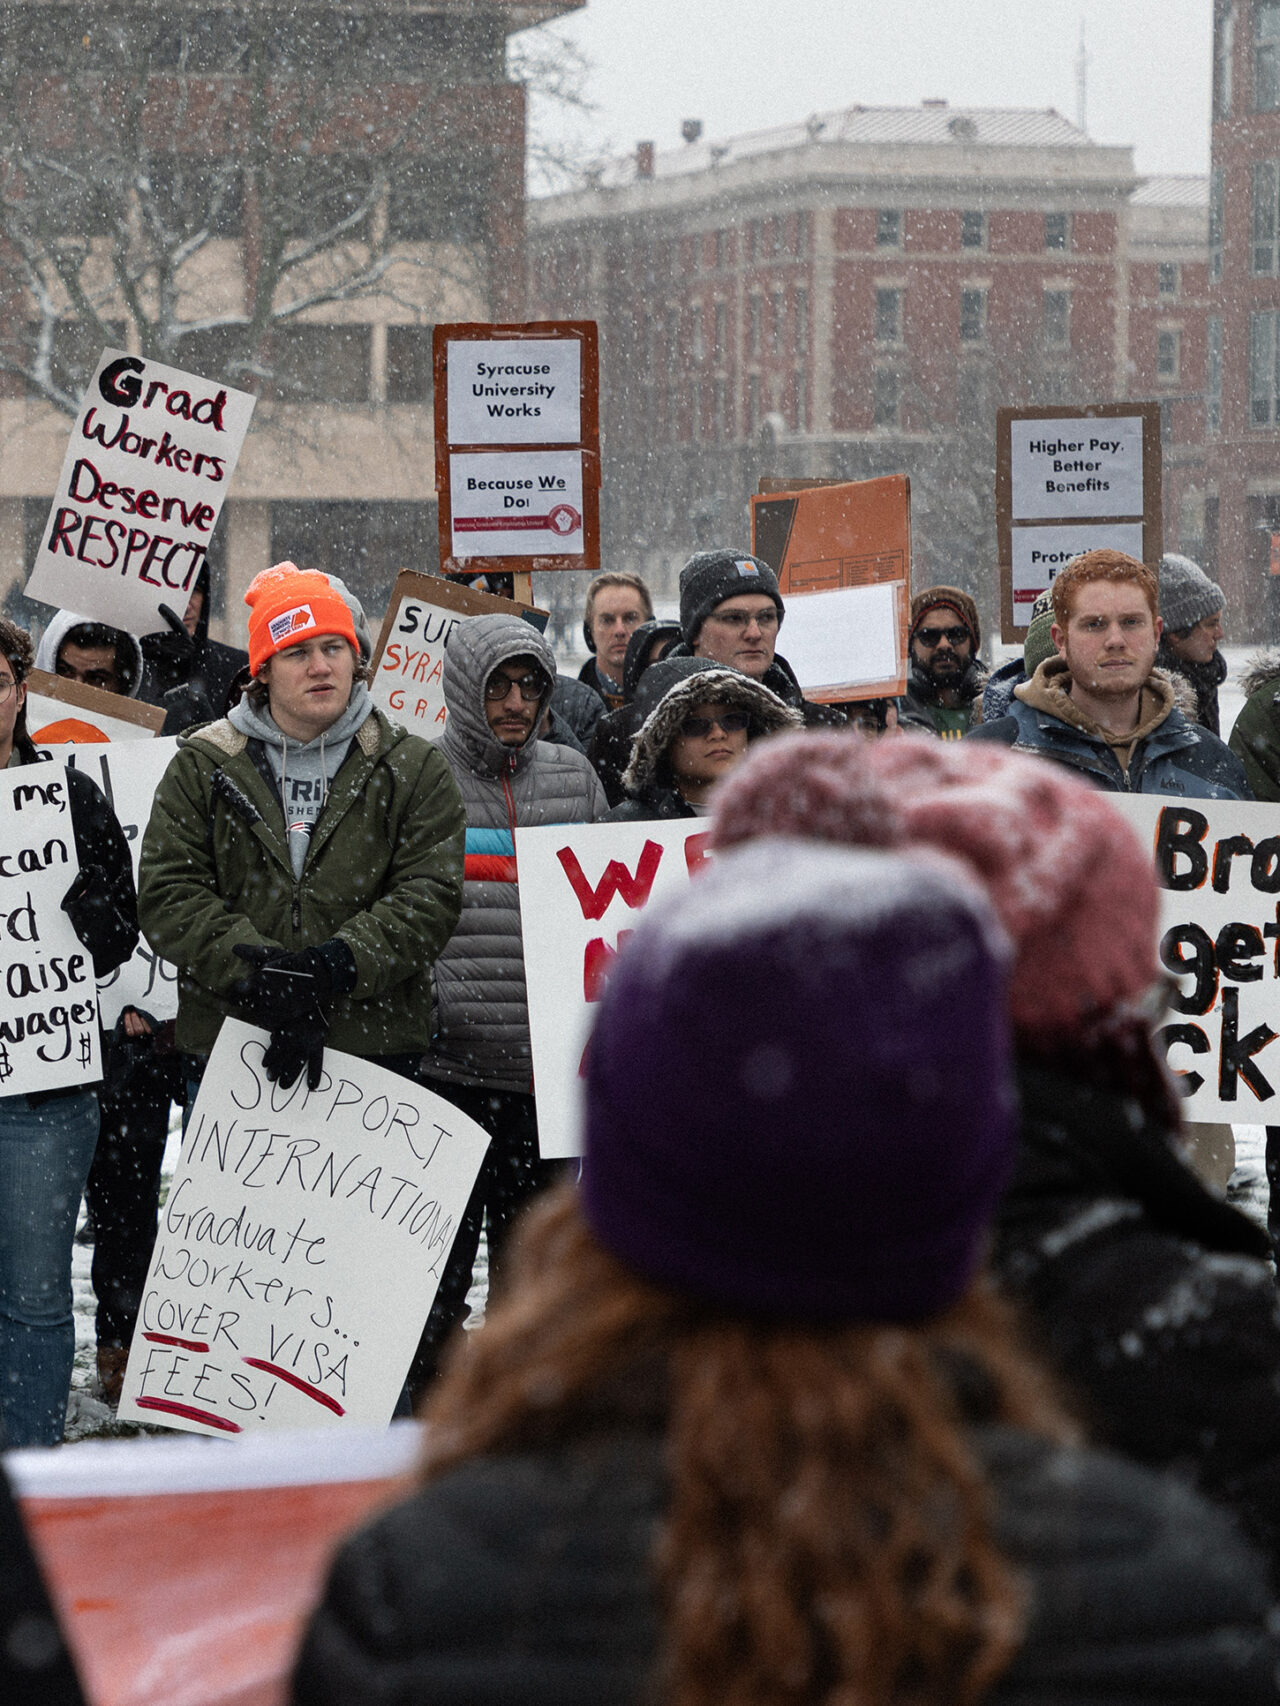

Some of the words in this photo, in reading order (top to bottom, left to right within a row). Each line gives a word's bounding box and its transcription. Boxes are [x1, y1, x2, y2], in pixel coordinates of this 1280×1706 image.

[476, 362, 551, 379] Syracuse
[98, 356, 227, 433] Grad
[472, 383, 556, 399] University
[487, 403, 542, 418] Works
[82, 407, 226, 482] Workers
[1029, 439, 1084, 456] Higher
[467, 478, 534, 491] Because
[538, 476, 567, 489] We
[1046, 478, 1111, 493] Benefits
[1053, 459, 1103, 473] Better
[68, 458, 215, 532] Deserve
[47, 507, 208, 592] RESPECT
[12, 781, 67, 814] me,
[76, 1031, 92, 1070] $
[230, 1040, 453, 1170] SUPPORT
[166, 1178, 327, 1266] Graduate
[142, 1290, 240, 1351] COVER
[270, 1324, 350, 1398] VISA
[139, 1348, 278, 1421] FEES!
